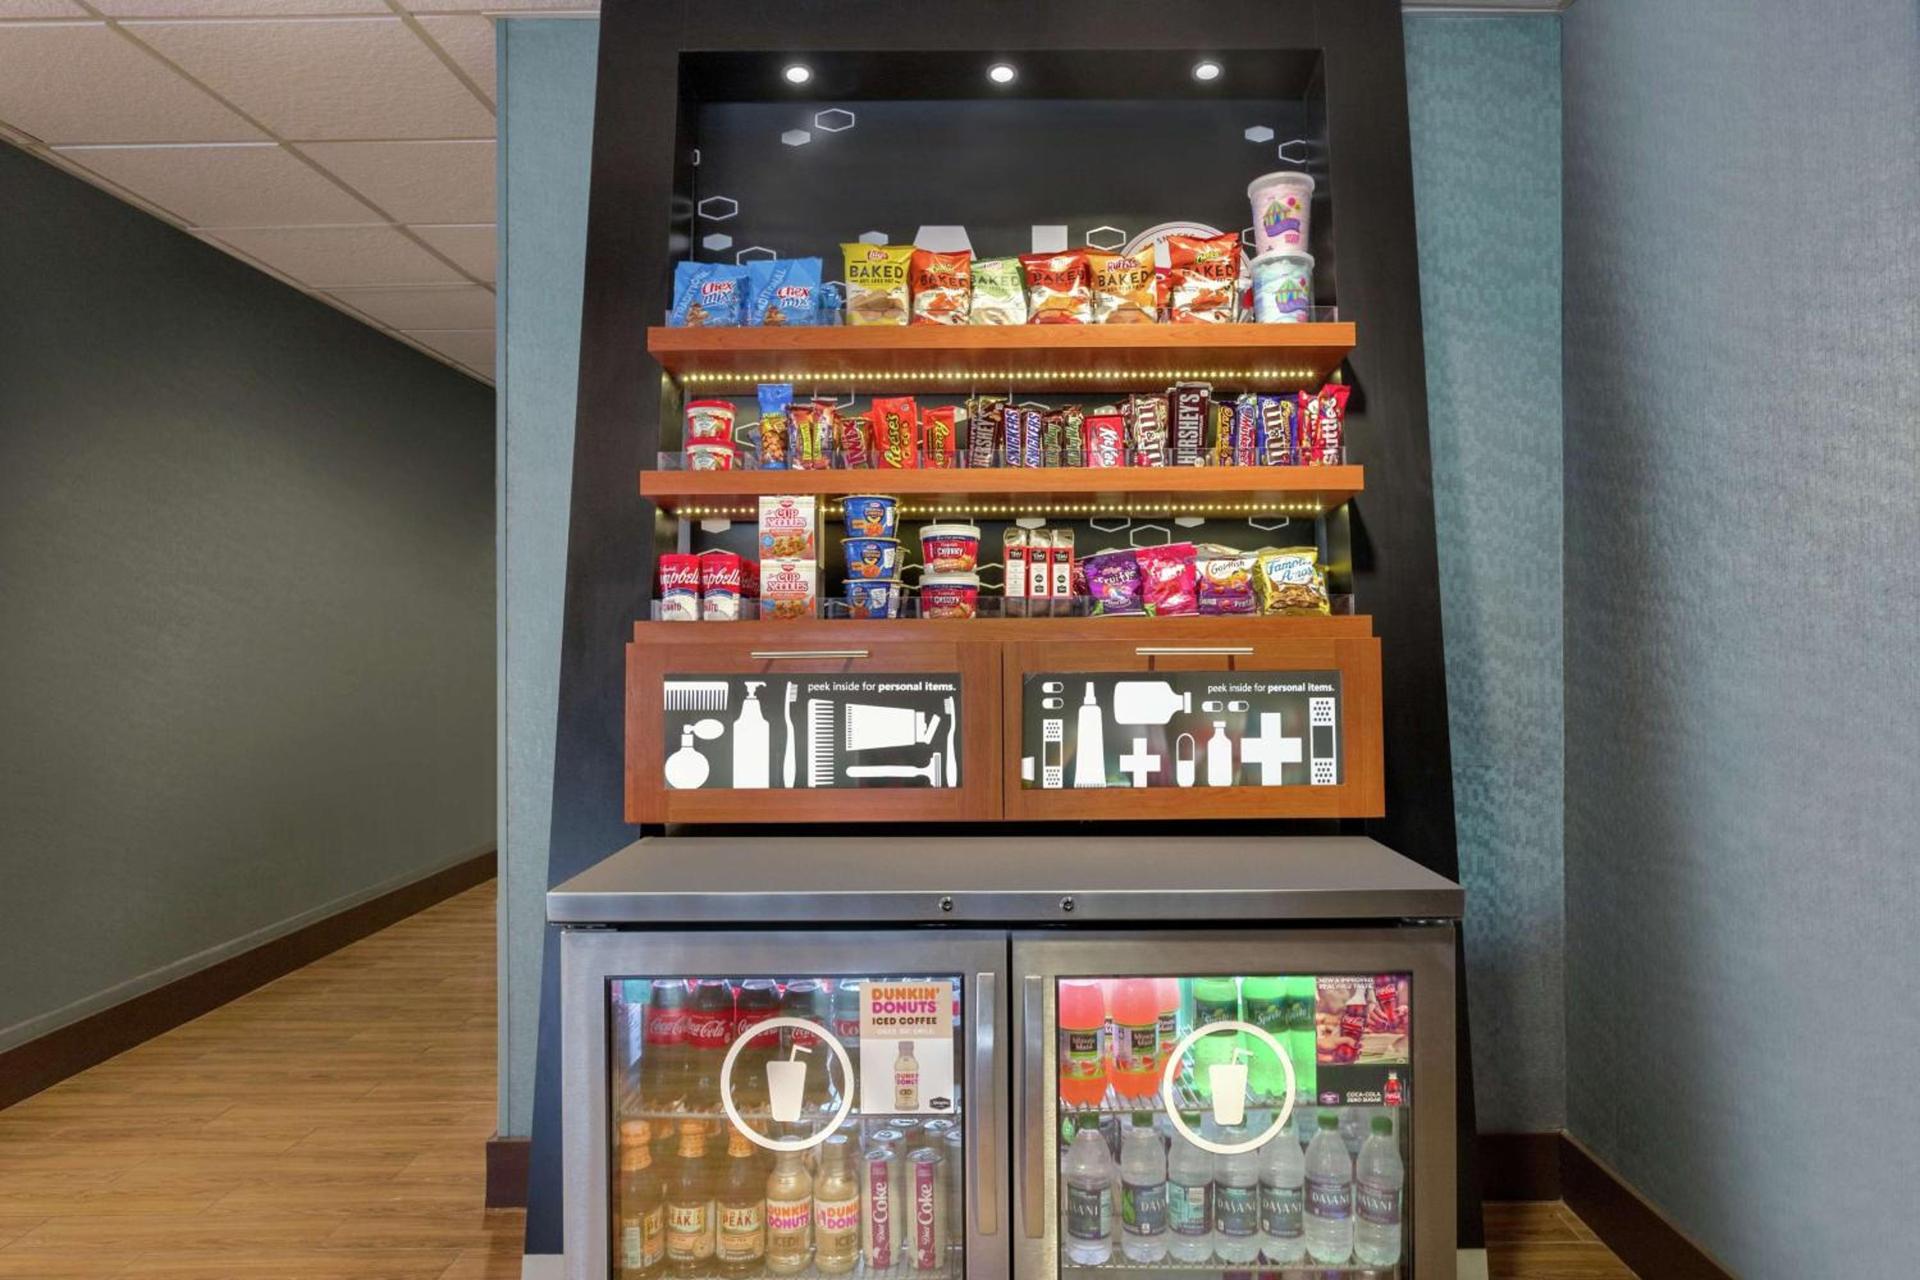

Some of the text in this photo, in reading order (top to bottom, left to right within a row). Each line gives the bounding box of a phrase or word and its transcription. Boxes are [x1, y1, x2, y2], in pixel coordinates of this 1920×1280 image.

[850, 265, 904, 278] BAKED
[920, 271, 966, 286] BAKED
[1033, 268, 1085, 284] BAKED
[1098, 270, 1149, 287] BAKED
[702, 281, 734, 295] Chex
[777, 285, 811, 299] Chex
[1177, 393, 1200, 465] HERSHEY'S
[1319, 397, 1339, 465] Skittles
[1005, 407, 1021, 467] SNICKERS
[1025, 411, 1042, 467] SNICKERS
[775, 508, 799, 519] CUP
[1211, 560, 1246, 574] Goldfish
[776, 572, 801, 583] CUP
[808, 681, 957, 693] peek inside for personal items.
[1207, 682, 1335, 694] peek inside for personal items.
[871, 987, 940, 1000] DUNKIN'
[872, 1001, 937, 1014] DONUTS
[872, 1017, 938, 1025] ICED COFFEE
[873, 1181, 889, 1223] Coke
[917, 1183, 933, 1225] Coke
[1311, 1191, 1349, 1205] DASANI
[1217, 1200, 1256, 1213] DASANI
[1262, 1200, 1302, 1214] DASANI
[722, 1215, 753, 1227] PEAK
